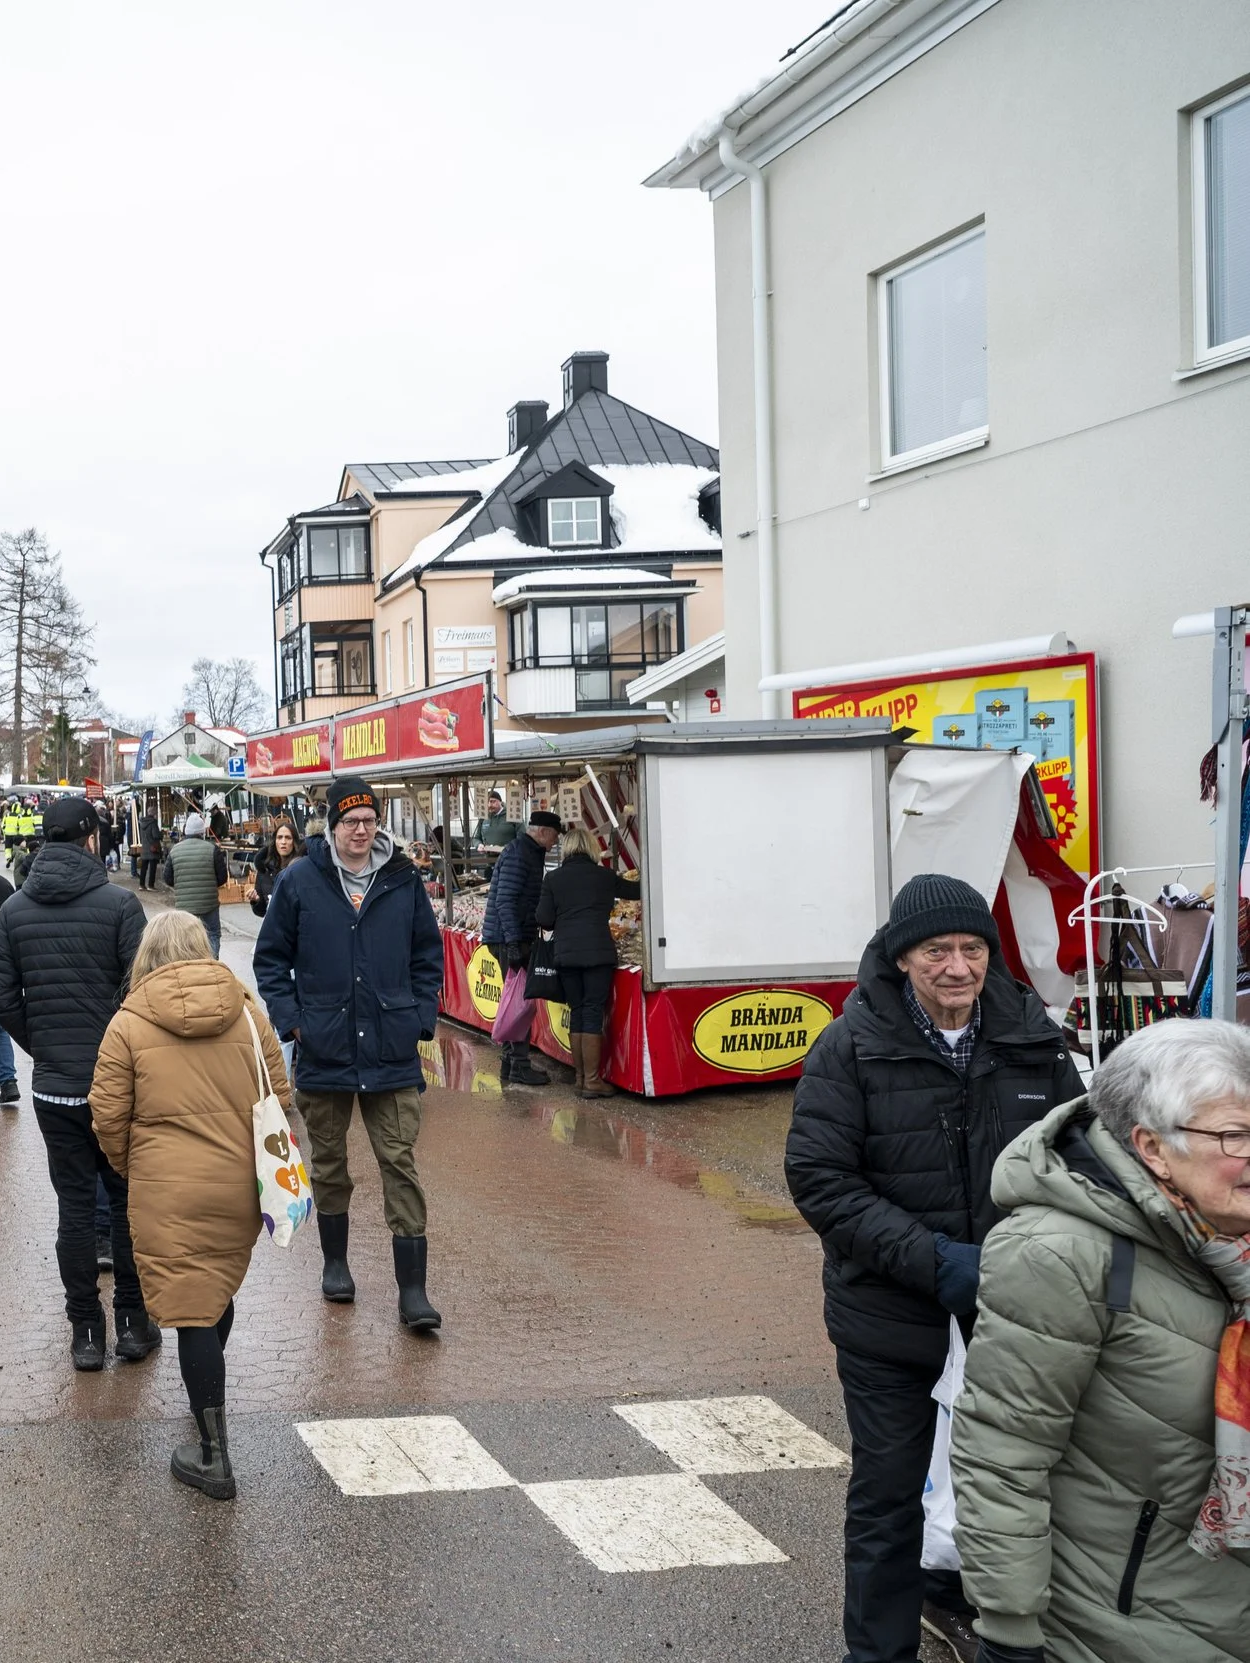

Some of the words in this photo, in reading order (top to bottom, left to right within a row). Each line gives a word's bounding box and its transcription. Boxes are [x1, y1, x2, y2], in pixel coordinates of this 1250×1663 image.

[437, 628, 492, 643] Freimans
[292, 734, 320, 767] MAGNUS
[342, 718, 386, 761] MANDLAR
[233, 759, 241, 772] P
[338, 794, 373, 812] OCKELBO
[730, 1003, 804, 1027] BRÄNDA
[720, 1029, 808, 1053] MANDLAR
